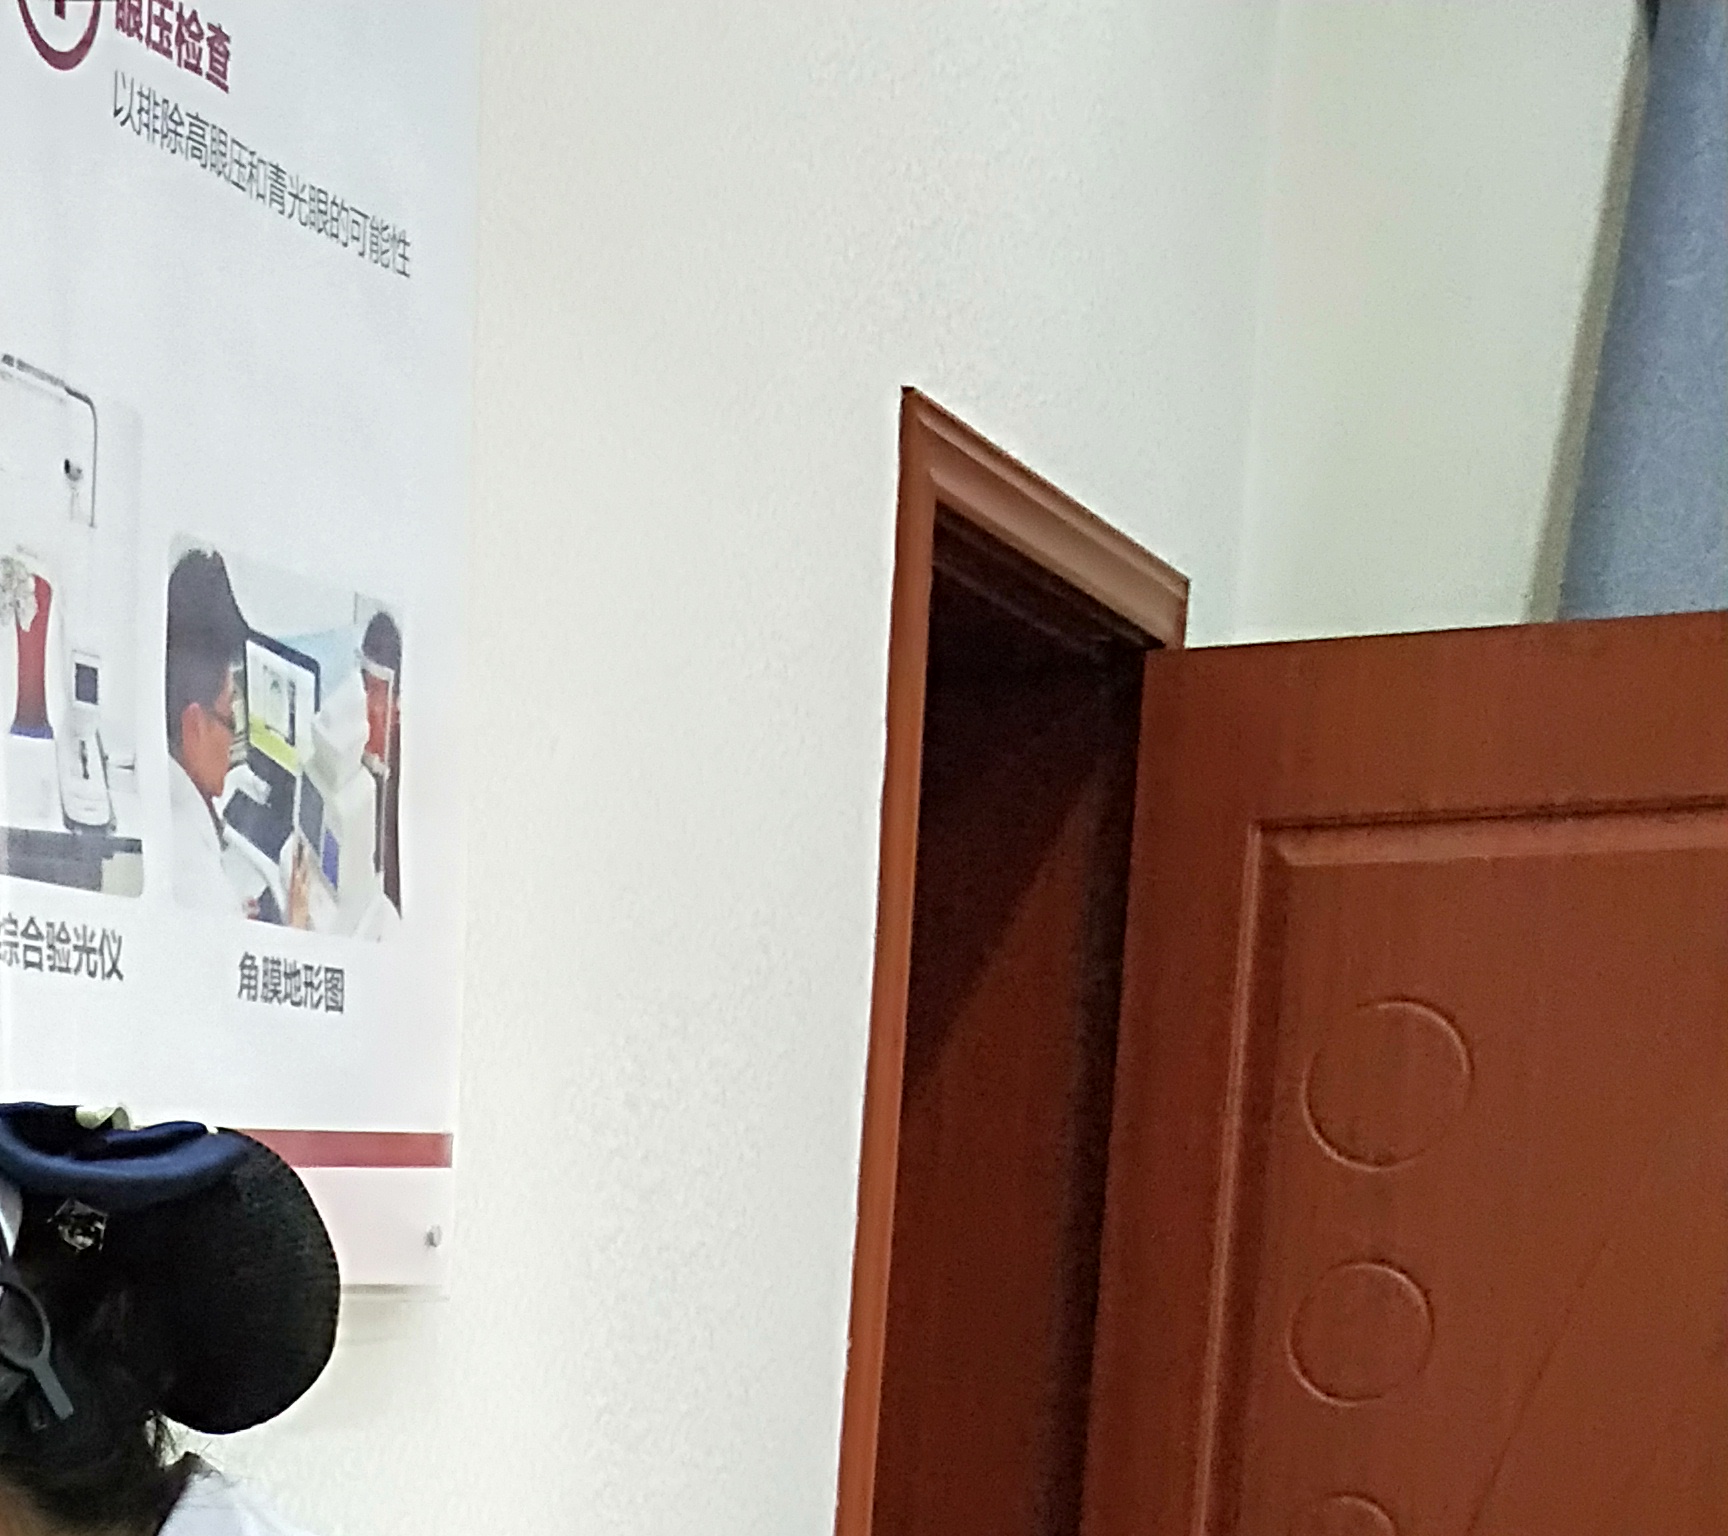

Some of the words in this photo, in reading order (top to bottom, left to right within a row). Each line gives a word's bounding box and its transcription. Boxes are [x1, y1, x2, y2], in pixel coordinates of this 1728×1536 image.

[113, 69, 412, 279] 以排除高眼压和青光眼的可能性
[237, 950, 345, 1015] 角膜地形图
